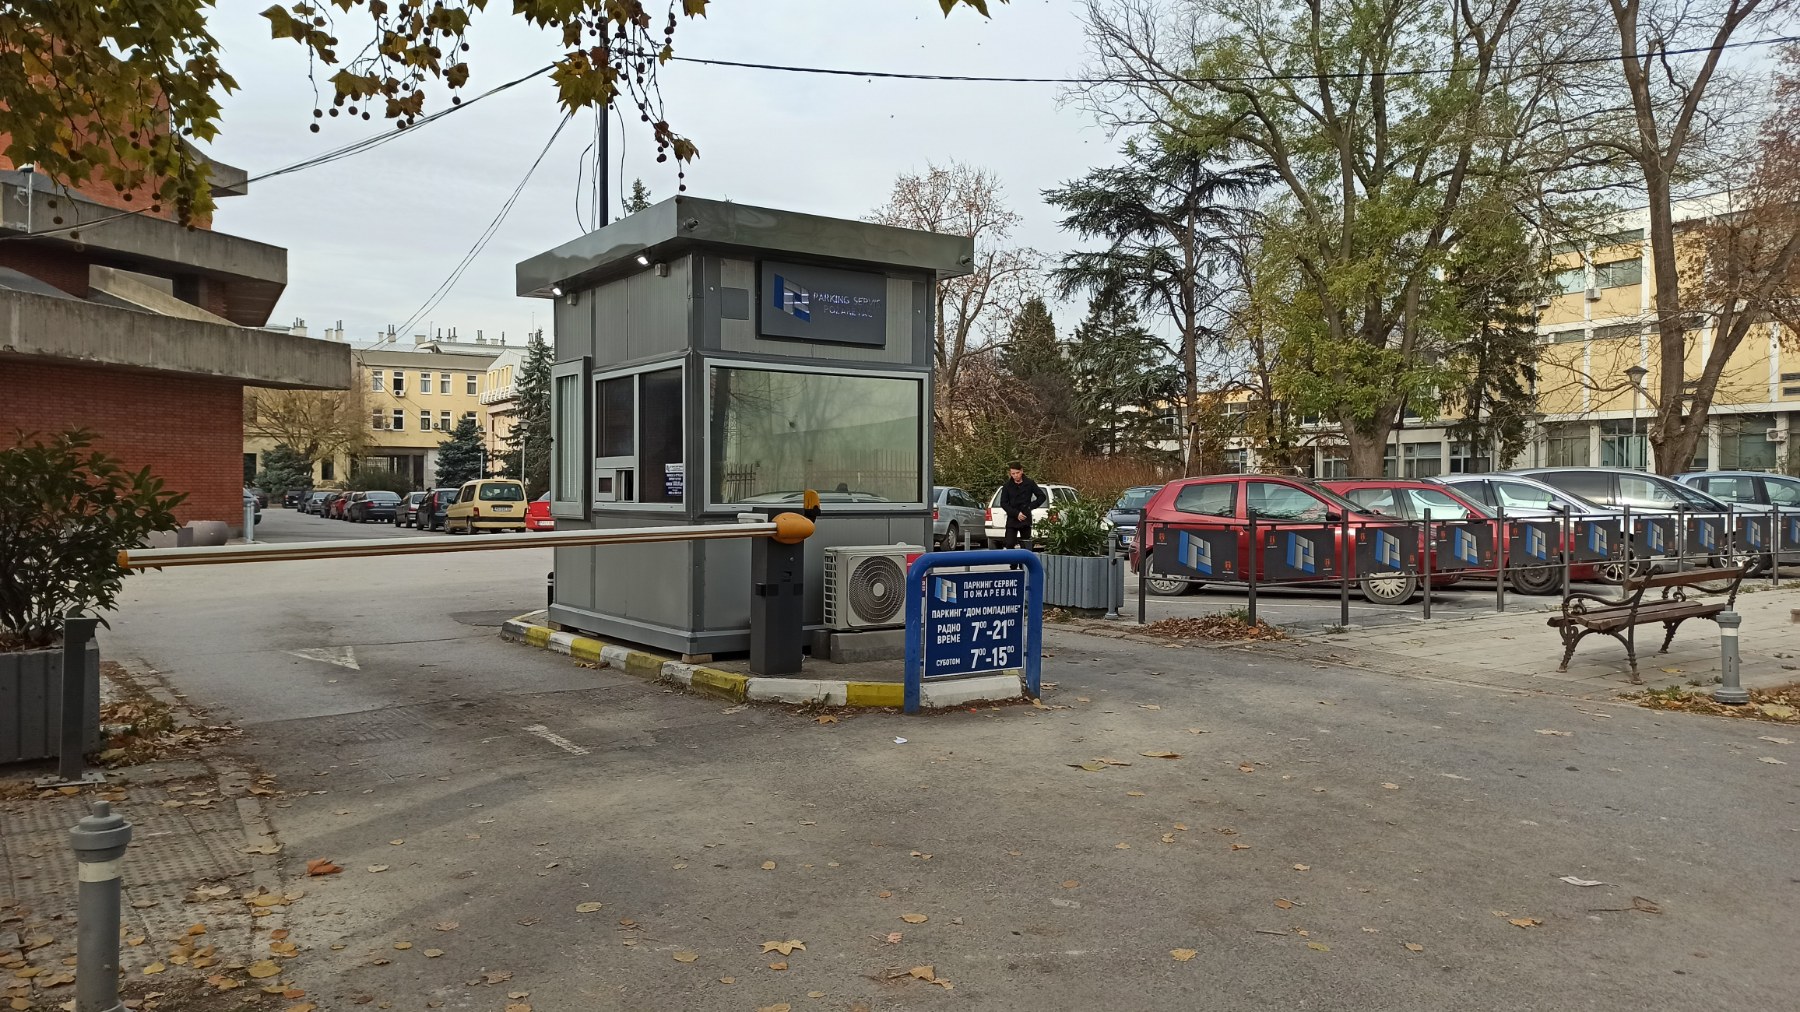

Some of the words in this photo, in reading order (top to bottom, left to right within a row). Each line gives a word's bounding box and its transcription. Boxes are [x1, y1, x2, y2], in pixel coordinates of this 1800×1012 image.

[813, 292, 850, 304] PARKING
[963, 580, 993, 590] ПАРКИНГ
[994, 579, 1018, 588] СЕРВИС
[963, 588, 1017, 598] ПОЖАРЕВАЦ
[931, 608, 962, 619] ПАРКИНГ
[982, 605, 1021, 615] ОМЛАДИНЕ"
[937, 623, 961, 634] РАДНО
[937, 634, 961, 645] ВРЕМЕ
[936, 658, 961, 667] СУБОТОМ
